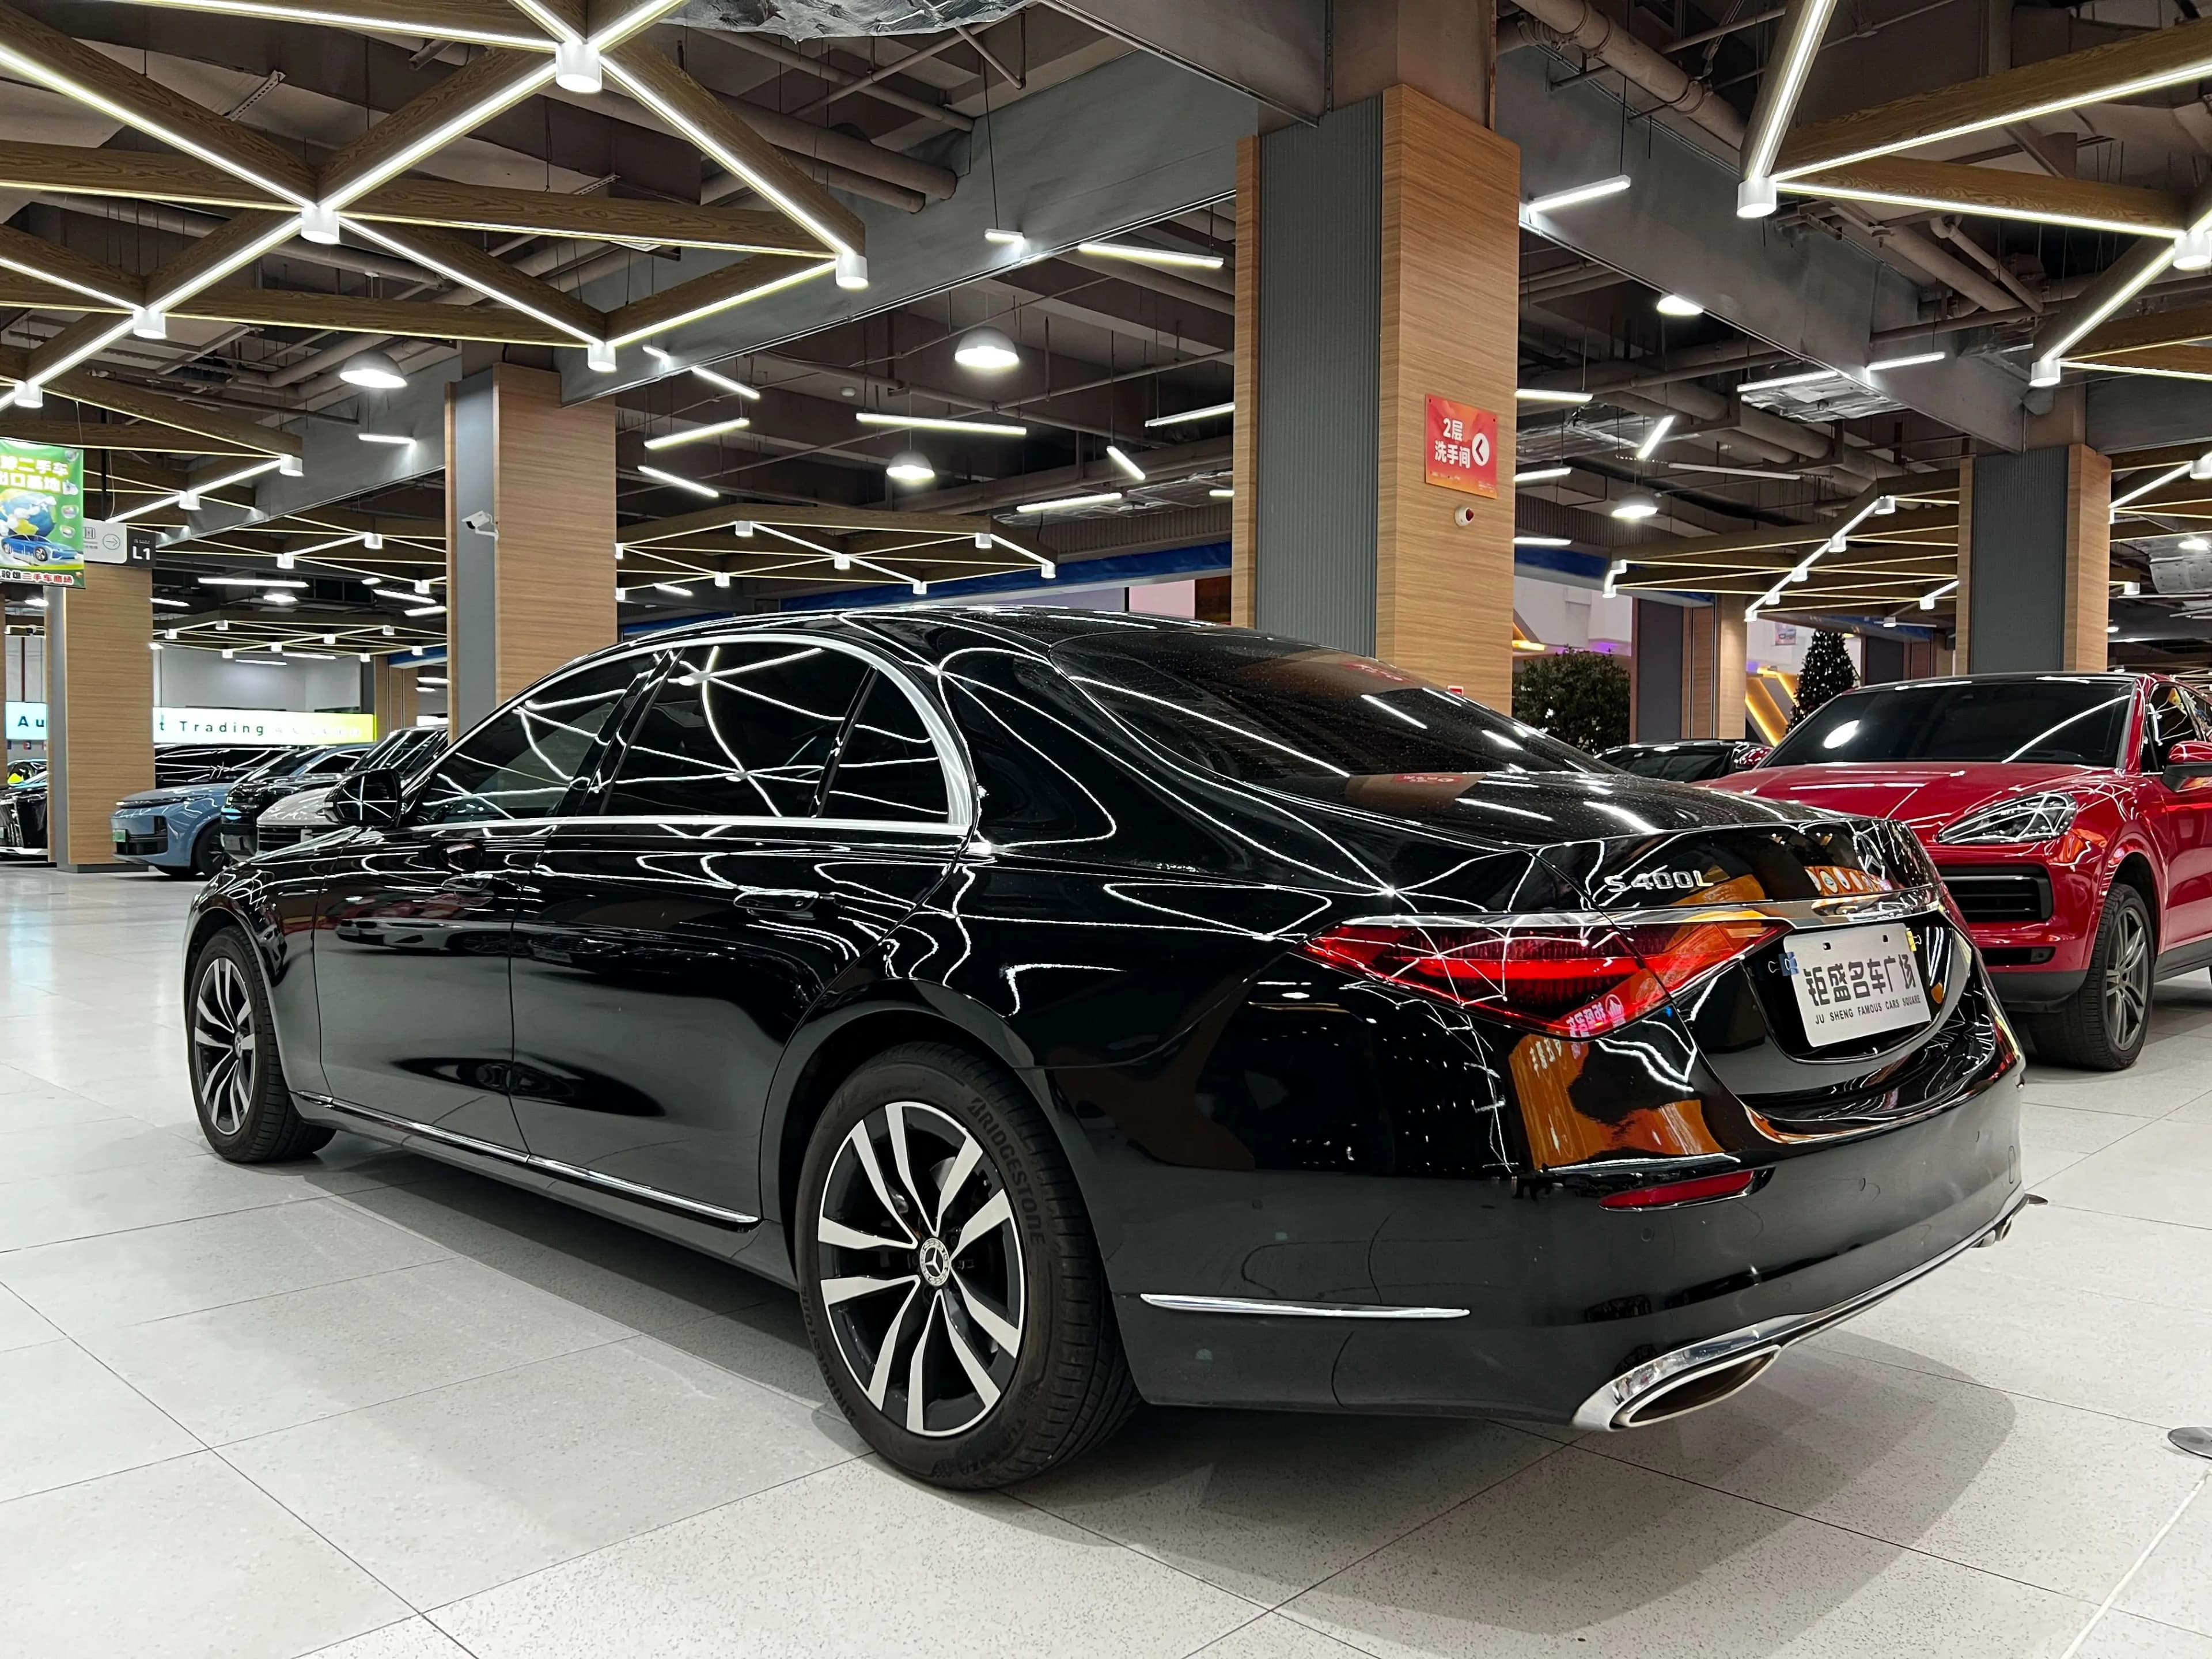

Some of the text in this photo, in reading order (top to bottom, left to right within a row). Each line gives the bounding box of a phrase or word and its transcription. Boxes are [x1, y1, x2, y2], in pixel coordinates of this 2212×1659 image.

[1442, 418, 1463, 442] 2层
[1434, 440, 1471, 469] 洗手间
[132, 546, 151, 560] L1
[17, 715, 45, 728] Au
[180, 721, 264, 736] Trading
[1803, 954, 1916, 1006] 钜盛名车广场
[1815, 994, 1921, 1025] JU SHENG FAMOUS CARS SQUARE
[966, 1096, 1046, 1245] BRIDGESTONE
